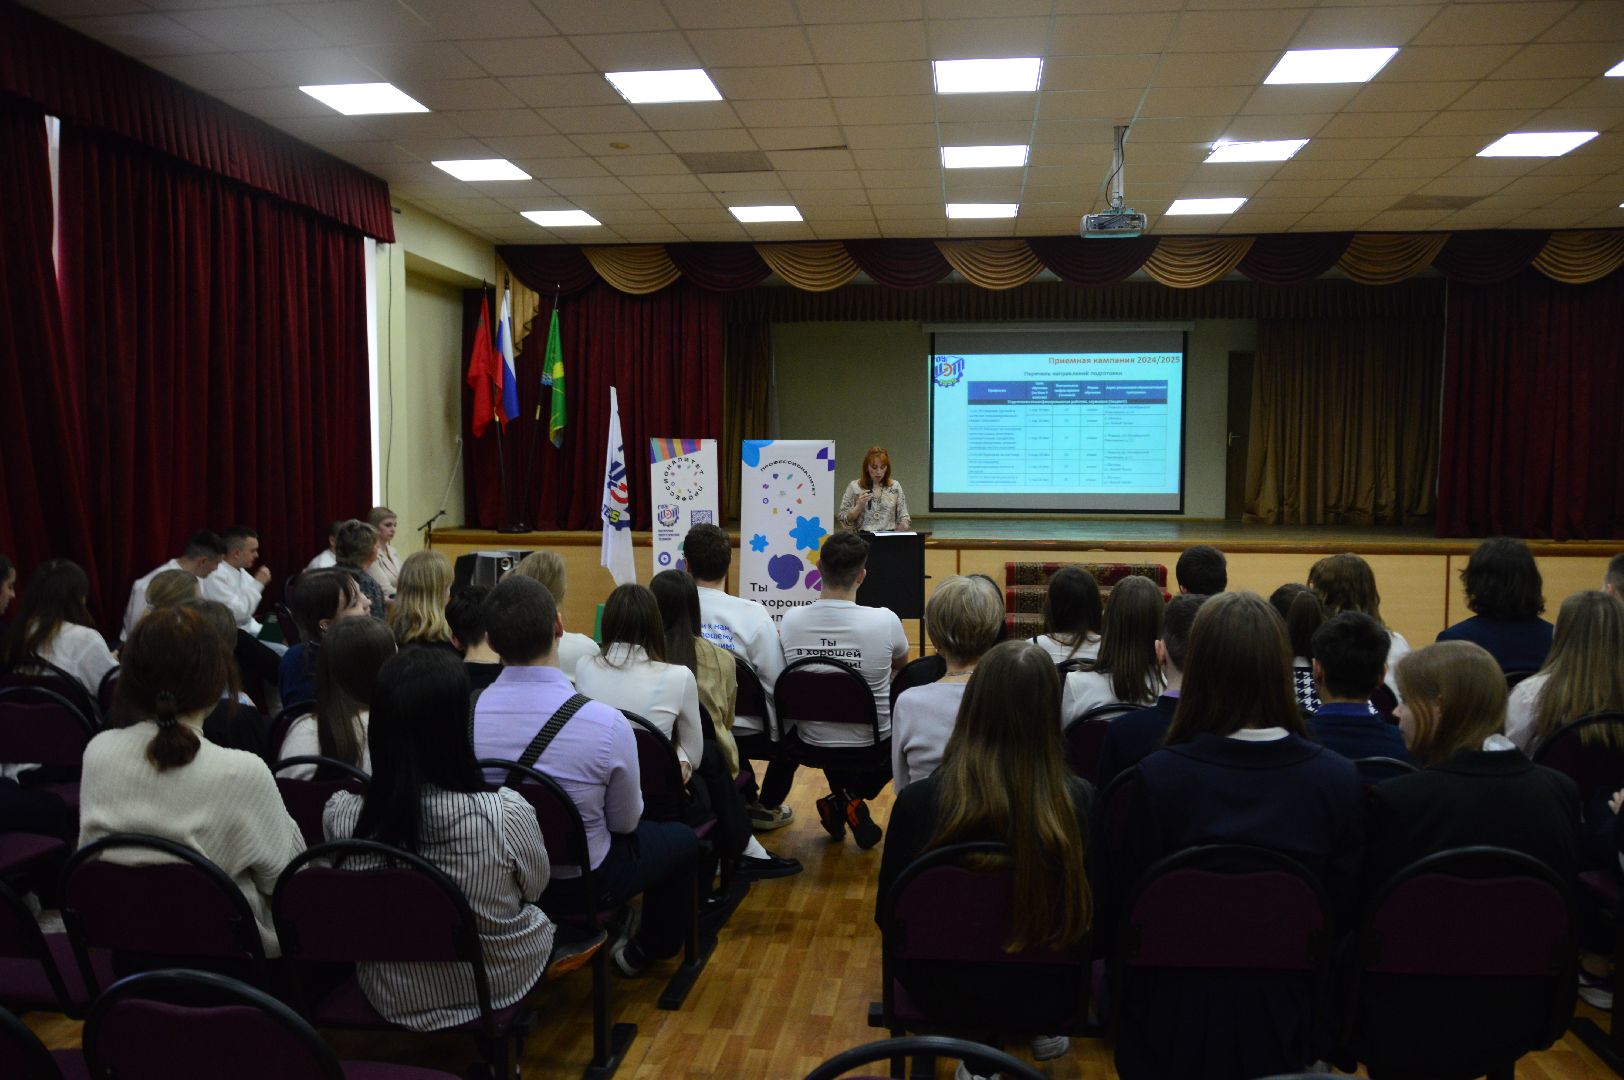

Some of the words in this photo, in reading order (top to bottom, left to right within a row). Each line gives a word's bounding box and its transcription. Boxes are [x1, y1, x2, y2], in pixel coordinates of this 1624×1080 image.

[1048, 357, 1091, 366] Приемная
[1137, 356, 1181, 365] 2024/2025
[664, 457, 704, 502] ПРОФЕССИОНАЛИТЕТ
[760, 460, 816, 496] ПРОФЕССИОНАЛИТЕТ
[750, 582, 768, 592] Ты
[820, 638, 837, 646] Ты
[806, 649, 862, 658] хорошей
